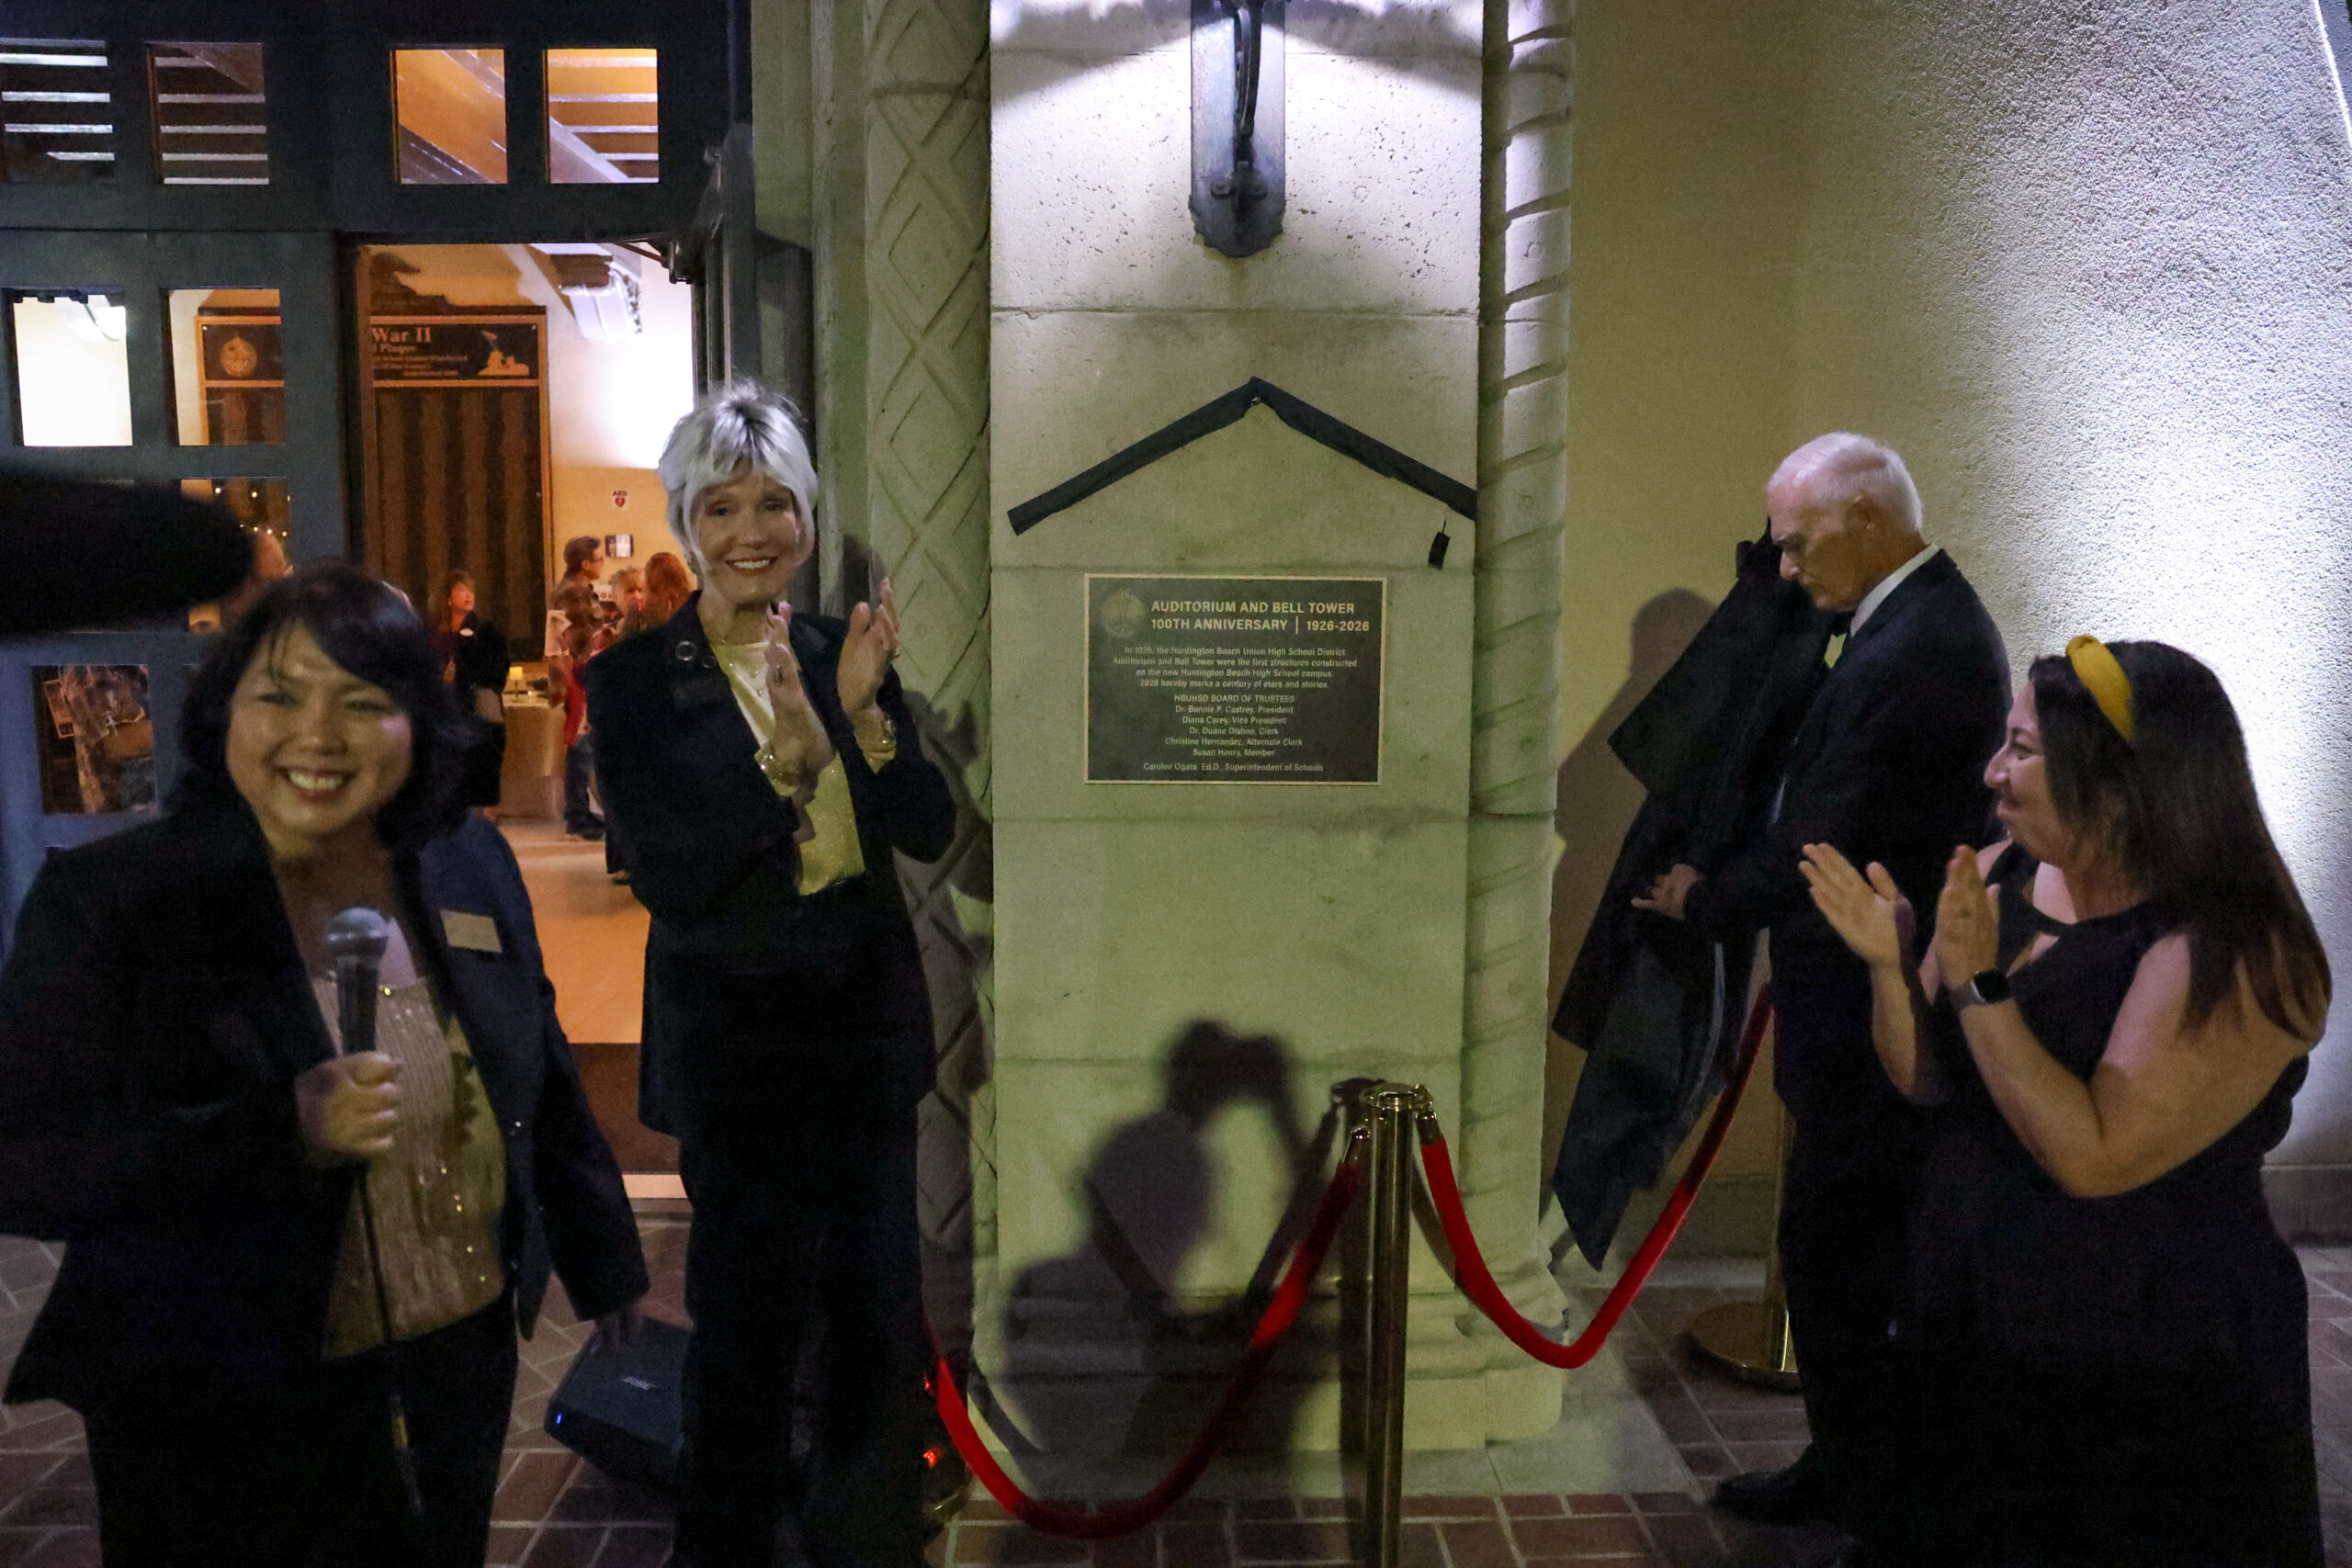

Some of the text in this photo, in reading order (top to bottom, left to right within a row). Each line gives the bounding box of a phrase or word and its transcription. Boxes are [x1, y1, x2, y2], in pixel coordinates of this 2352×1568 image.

[372, 327, 432, 343] War II
[1151, 600, 1354, 615] AUDITORIUM AND BELL TOWER
[1151, 618, 1370, 632] 100TH ANNIVERSARY 1926-2026
[1171, 647, 1215, 656] Huntington
[1216, 647, 1241, 655] Beach
[1268, 648, 1286, 657] High
[1288, 648, 1315, 656] School
[1317, 648, 1345, 656] District
[1113, 657, 1156, 665] Auditorium
[1238, 658, 1250, 666] the
[1252, 658, 1268, 666] first
[1270, 659, 1309, 667] structures
[1311, 659, 1357, 667] constructed
[1181, 669, 1224, 678] Huntington
[1252, 670, 1271, 679] High
[1160, 680, 1187, 688] hereby
[1222, 681, 1251, 689] century
[1253, 680, 1262, 688] of
[1211, 694, 1238, 703] BOARD
[1241, 694, 1252, 703] OF
[1255, 694, 1295, 703] TRUSTEES
[1175, 705, 1185, 713] Dr.
[1188, 705, 1215, 713] Bonnie
[1225, 705, 1256, 715] Castrey,
[1258, 705, 1294, 714] President
[1182, 716, 1204, 724] Diana
[1250, 716, 1286, 725] President
[1189, 727, 1200, 735] Dr.
[1202, 727, 1226, 735] Duane
[1259, 727, 1279, 735] Clerk
[1165, 737, 1199, 746] Christine
[1246, 738, 1281, 746] Alternate
[1283, 738, 1303, 746] Clerk
[1143, 762, 1172, 771] Carolee
[1225, 762, 1283, 772] Superintendent
[1294, 763, 1324, 772] Schools
